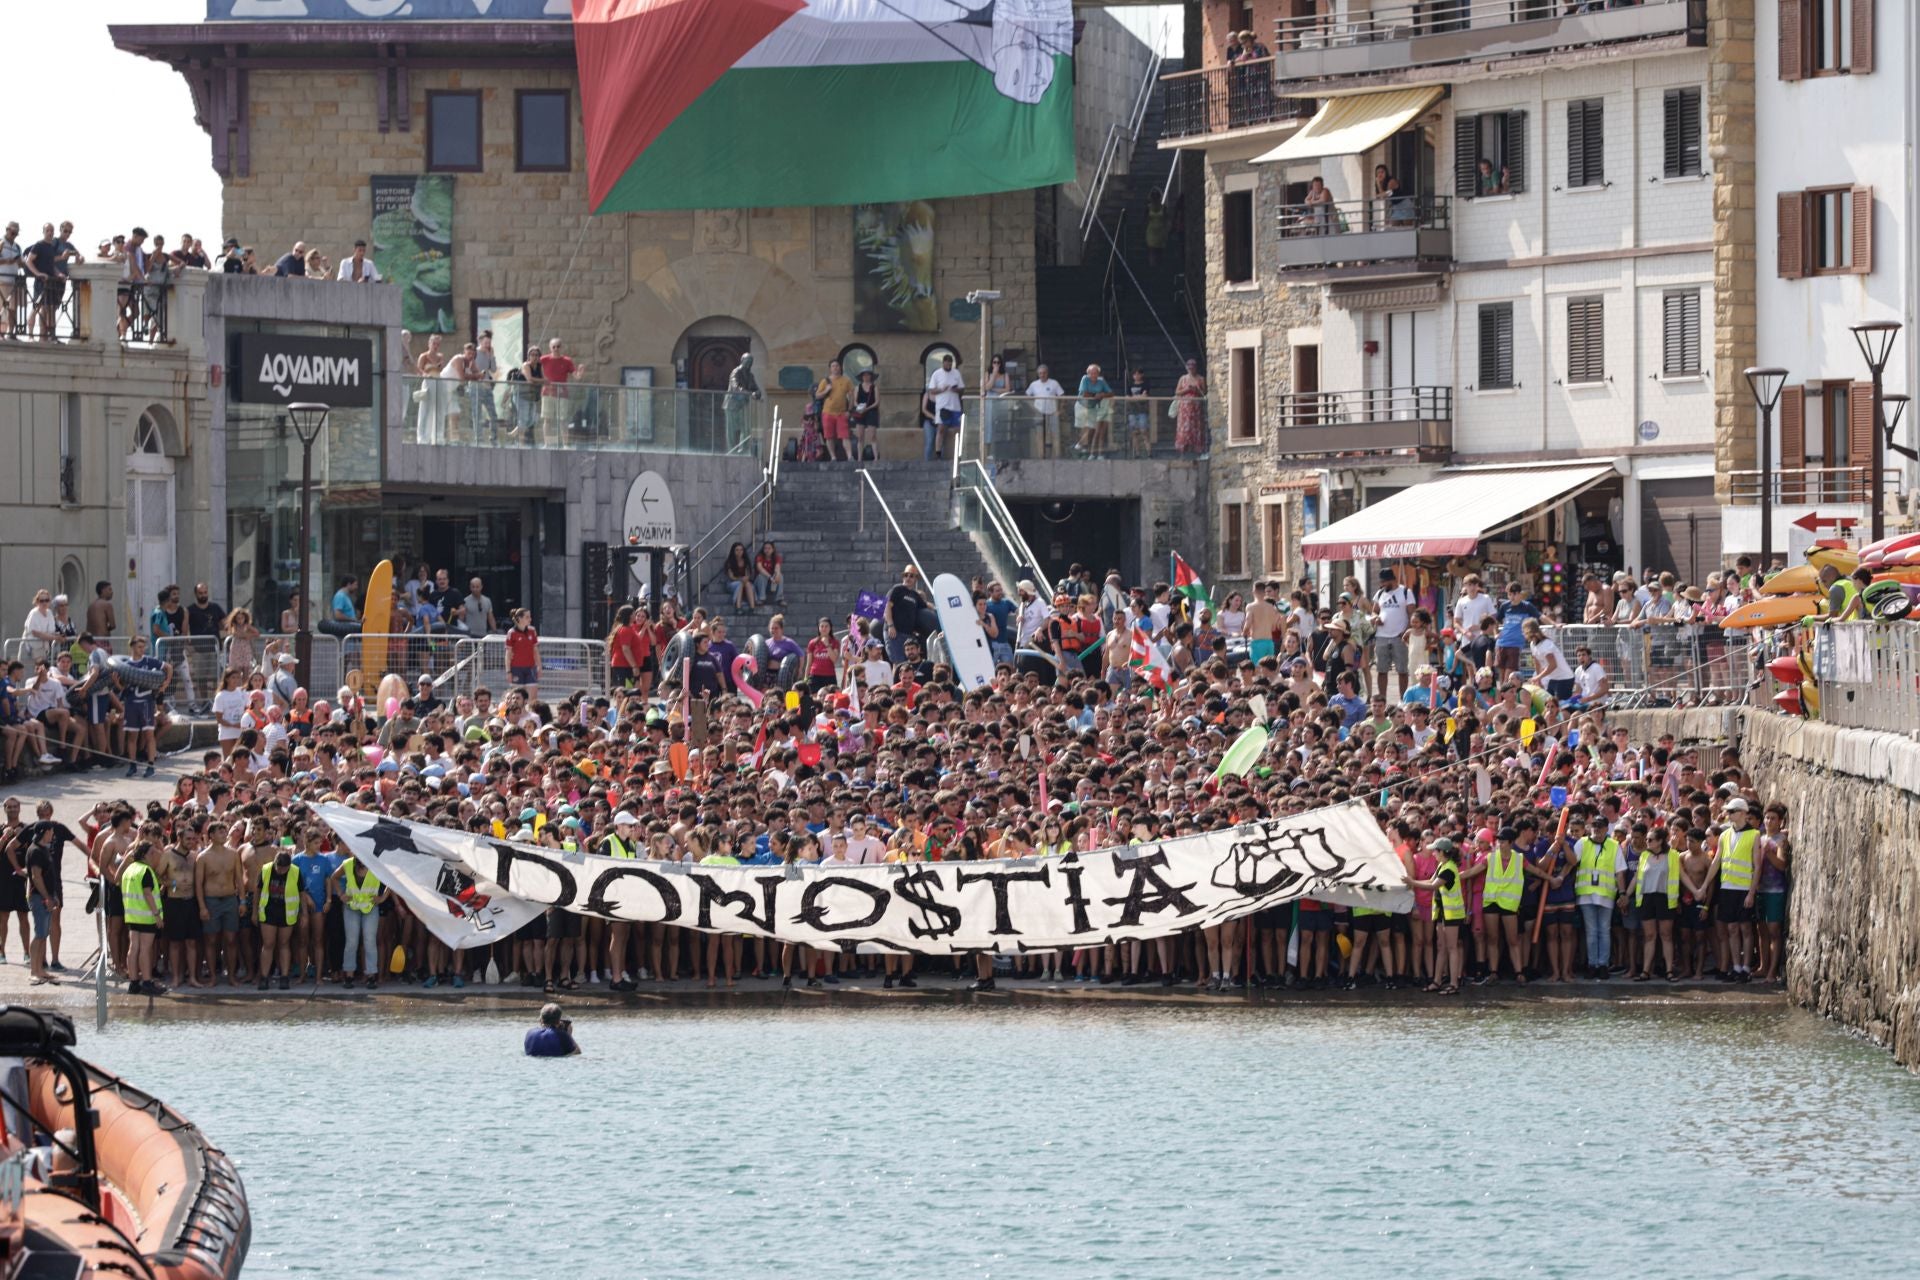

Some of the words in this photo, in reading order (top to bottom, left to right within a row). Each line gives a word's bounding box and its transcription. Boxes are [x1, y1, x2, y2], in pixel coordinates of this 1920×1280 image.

[259, 353, 359, 397] AQVARIVM
[1351, 544, 1377, 558] BAZAR
[1381, 542, 1424, 558] AQUARIUM
